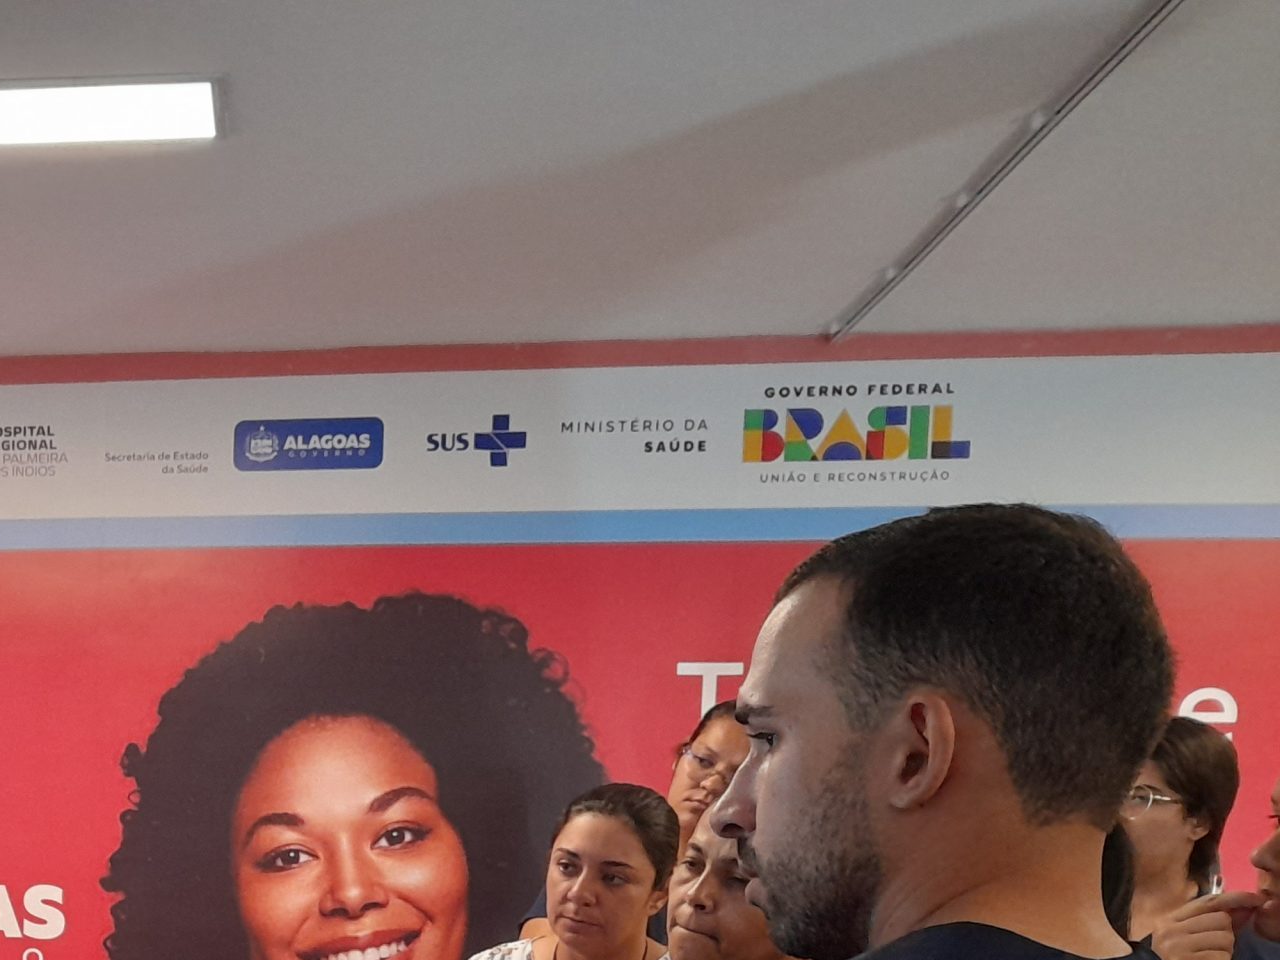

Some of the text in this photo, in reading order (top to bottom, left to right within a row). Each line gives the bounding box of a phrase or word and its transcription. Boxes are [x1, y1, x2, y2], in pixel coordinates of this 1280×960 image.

[764, 383, 955, 398] GOVERNO FEDERAL
[561, 417, 709, 433] MINISTÉRIO DA
[283, 433, 371, 450] ALAGOAS
[426, 432, 469, 451] SUS
[742, 405, 971, 463] BRASIL
[644, 437, 707, 453] SAÚDE
[2, 451, 69, 464] PALMEIRA
[104, 451, 209, 462] Secretaria de Estado
[288, 450, 366, 459] GOVERNO
[161, 464, 209, 474] da Saúde
[760, 469, 950, 484] UNIÃO E RECONSTRUÇÃO
